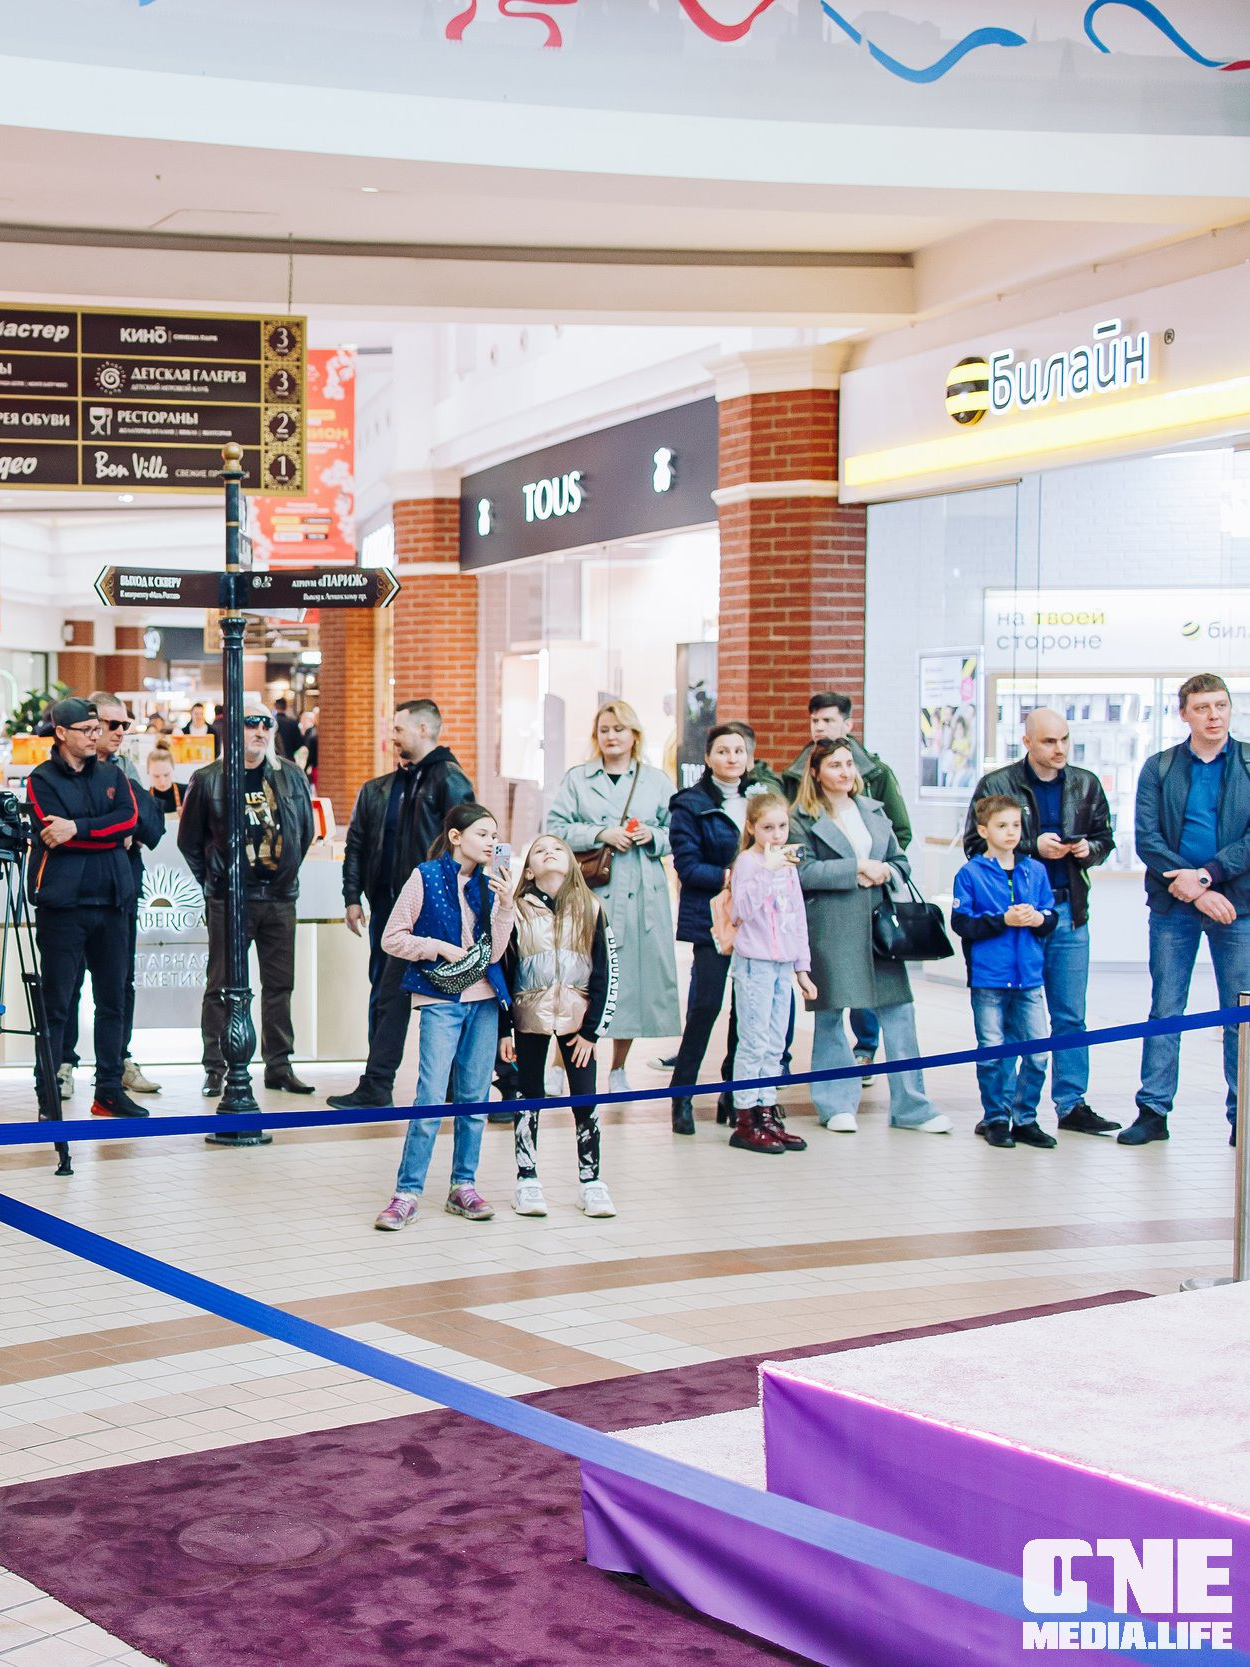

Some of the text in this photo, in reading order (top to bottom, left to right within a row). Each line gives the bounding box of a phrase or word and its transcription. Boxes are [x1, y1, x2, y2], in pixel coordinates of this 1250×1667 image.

[276, 327, 288, 348] 3
[131, 367, 247, 383] ДЕТСКАЯ ГАЛЕРЕЯ
[276, 370, 288, 390] 3
[21, 412, 70, 426] ОБУВИ
[118, 411, 199, 425] РЕСТОРАНЫ
[276, 411, 289, 433] 2
[94, 451, 168, 479] Bon Ville
[276, 455, 287, 475] 1
[522, 470, 581, 523] TOUS
[997, 612, 1024, 625] на
[1208, 621, 1250, 639] бил
[997, 635, 1102, 654] стороне
[136, 954, 209, 969] ТАРНАЯ
[135, 972, 207, 987] СМЕТИК
